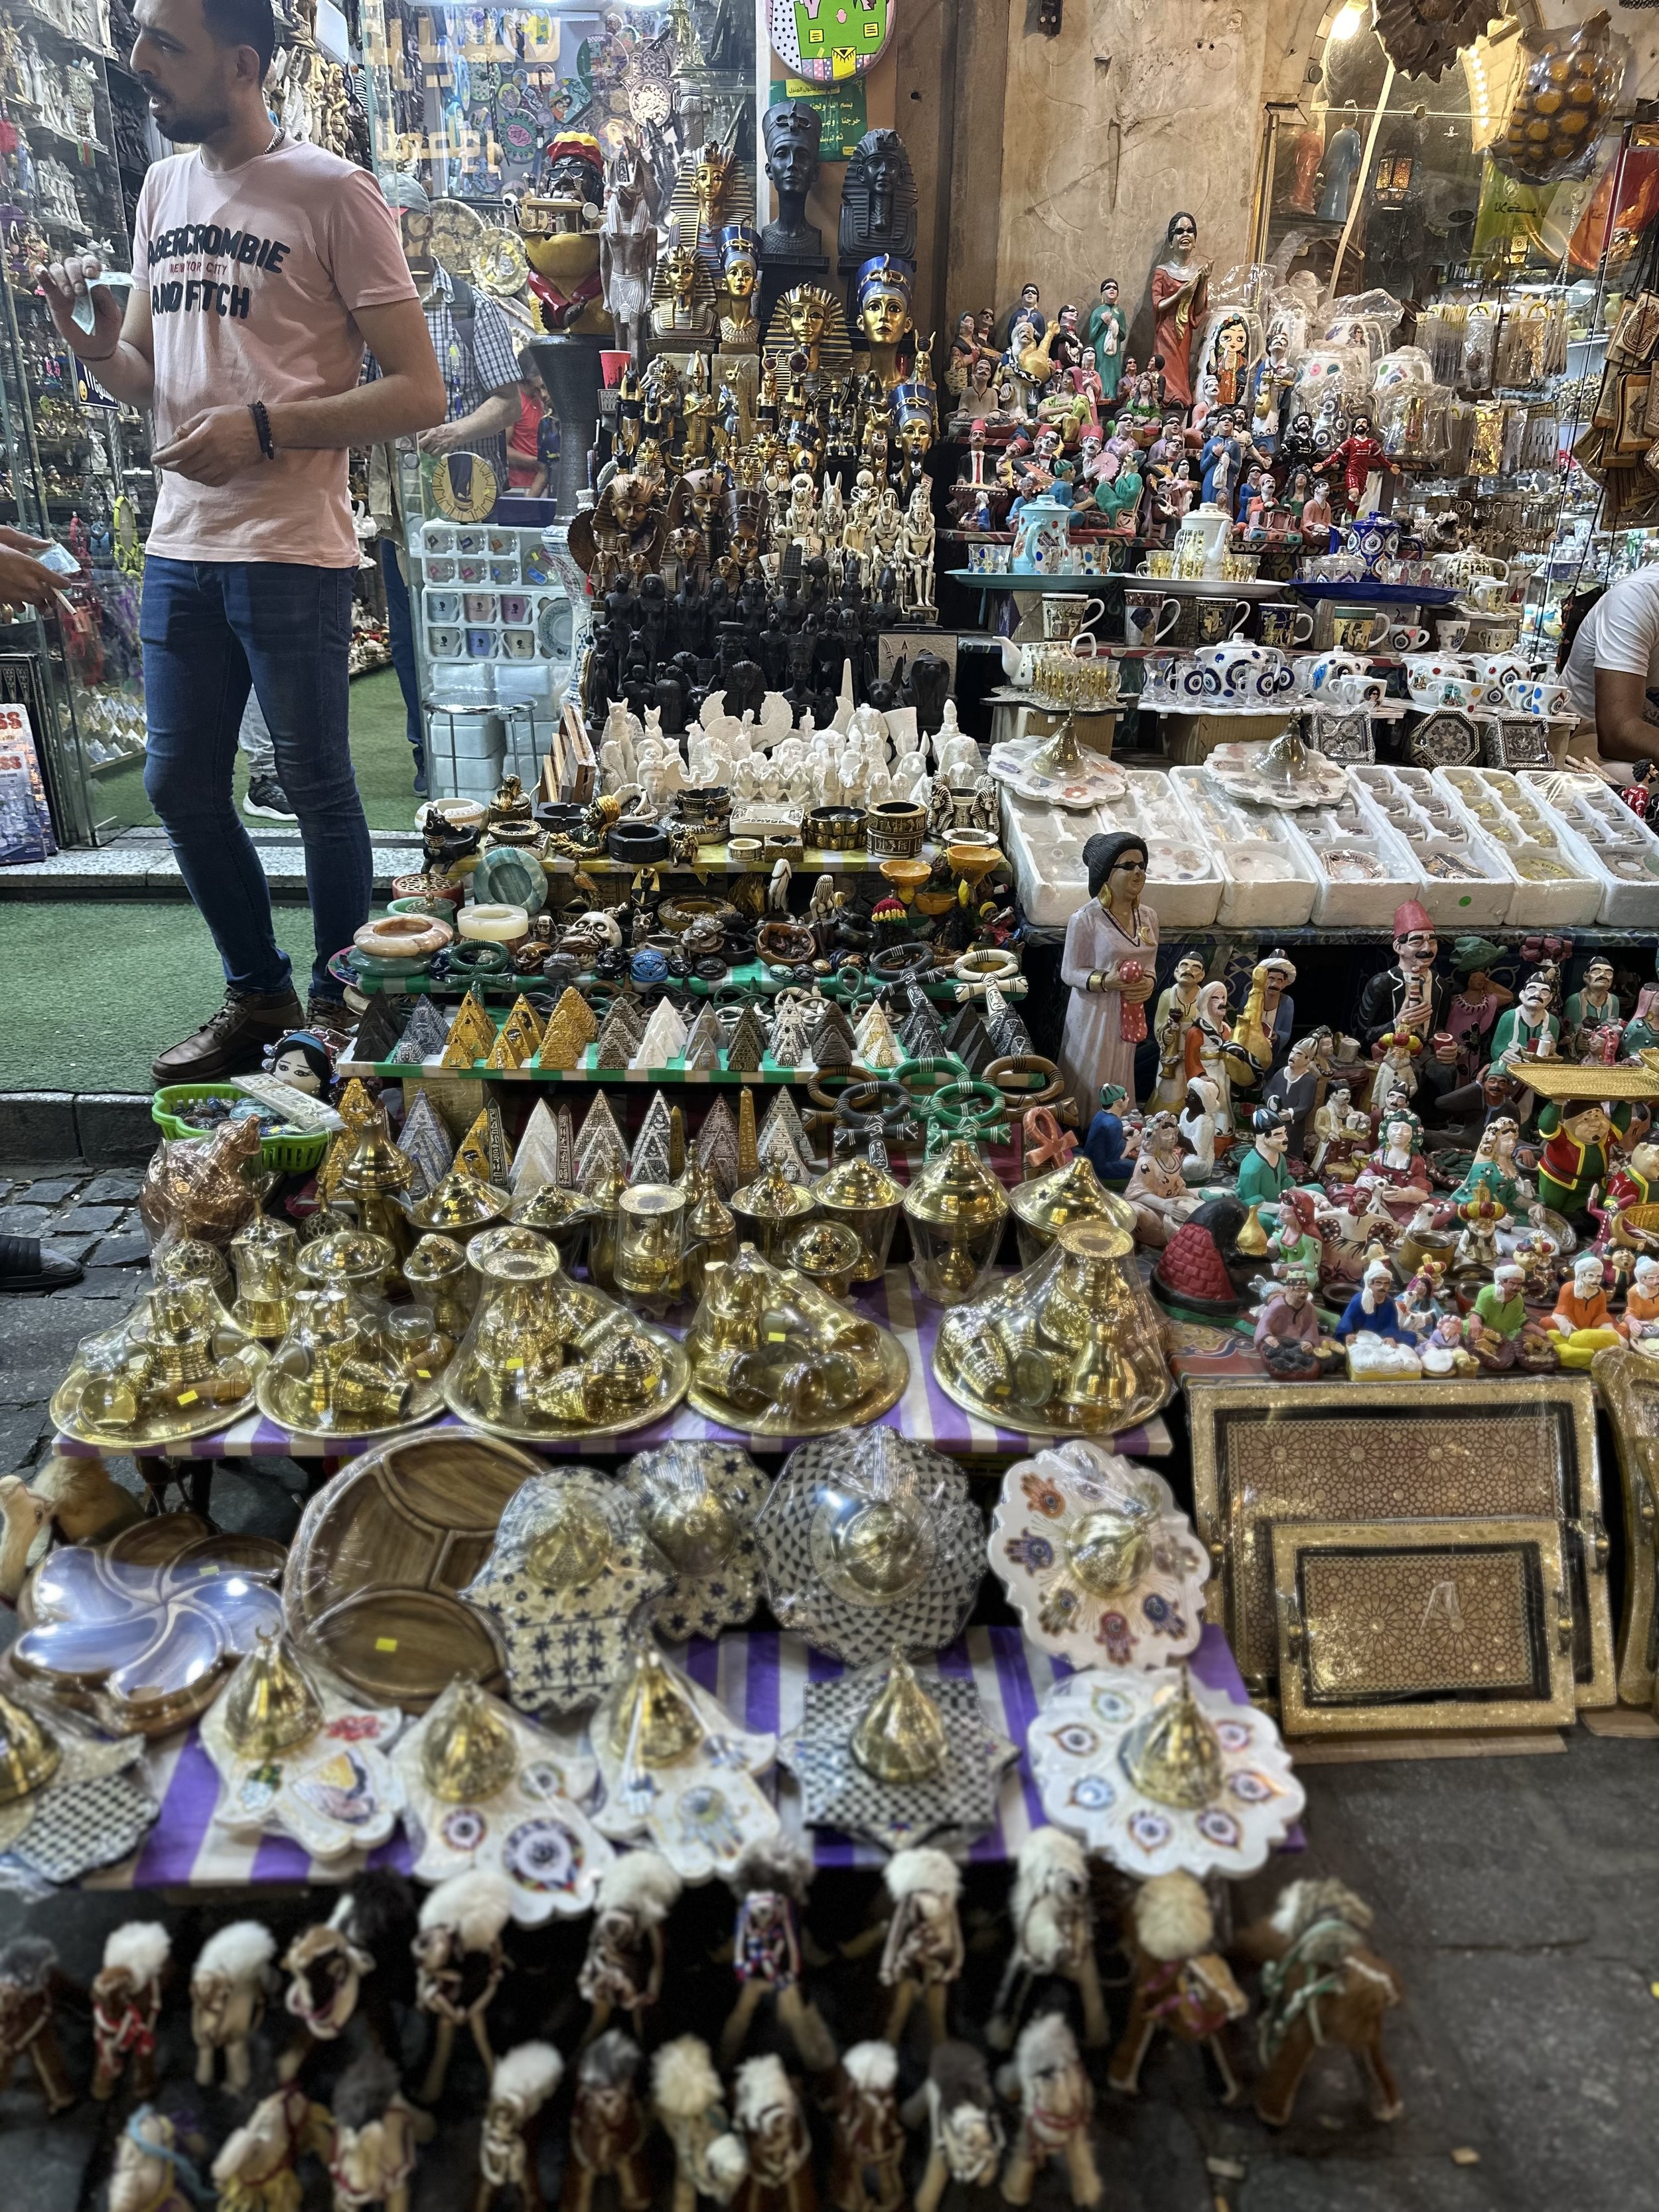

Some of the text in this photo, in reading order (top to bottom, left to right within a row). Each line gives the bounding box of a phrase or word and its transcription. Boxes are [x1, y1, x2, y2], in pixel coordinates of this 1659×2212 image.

[148, 224, 291, 273] ABERCROMBIE
[170, 263, 185, 274] NEW
[206, 262, 227, 275] CITY
[152, 279, 250, 319] AND FTCH
